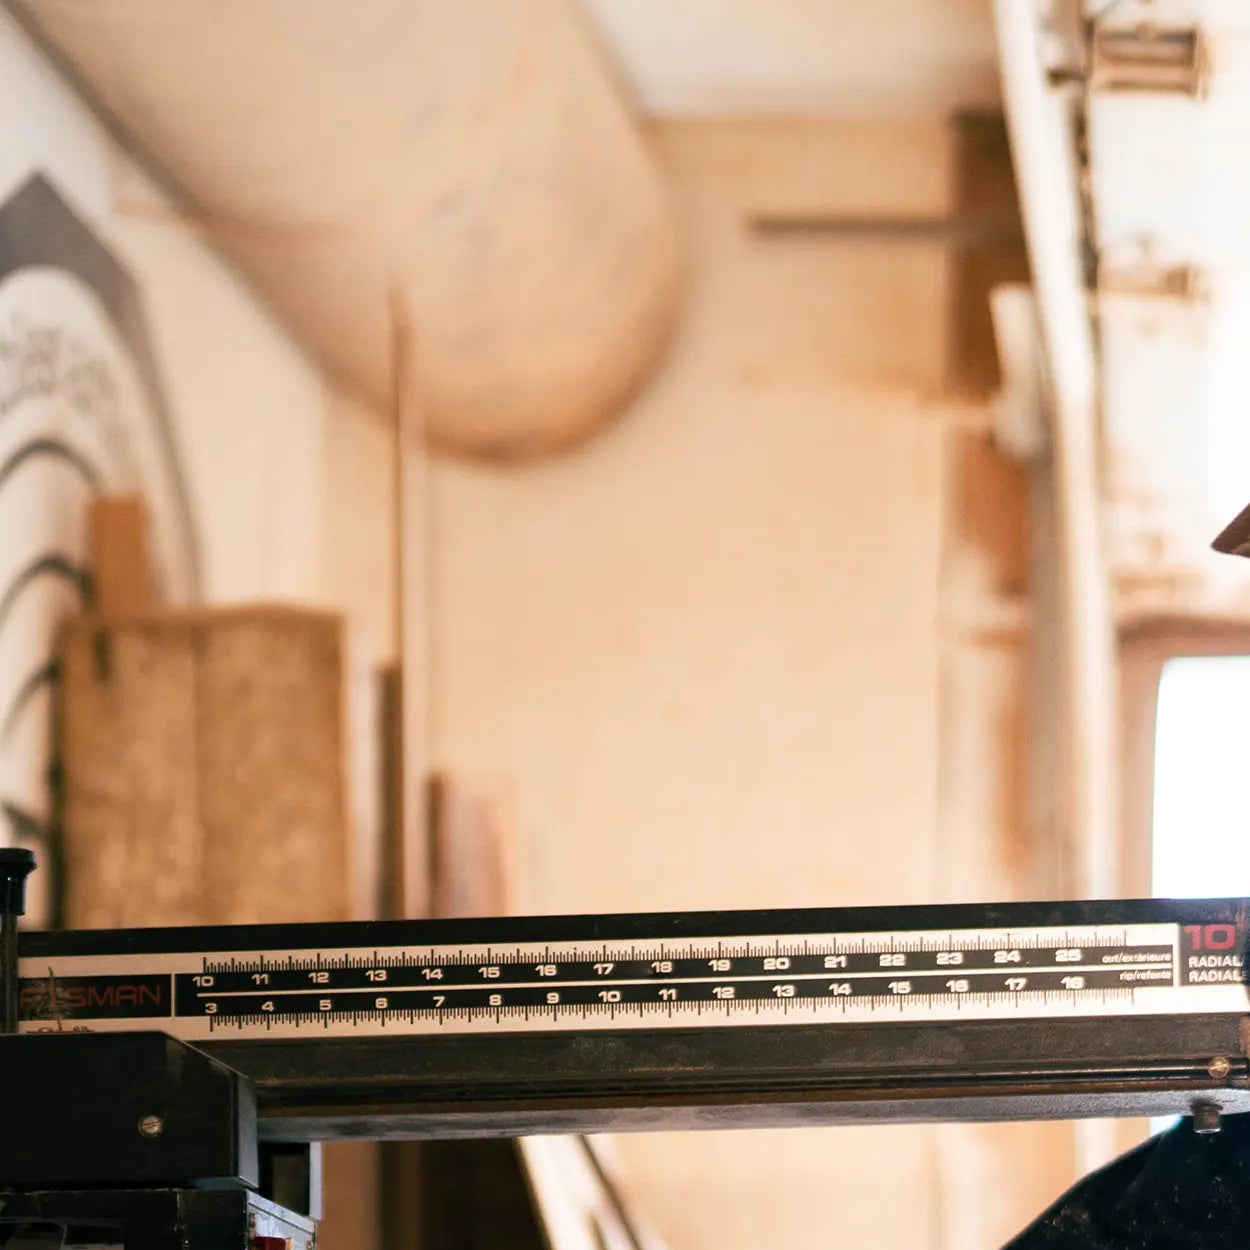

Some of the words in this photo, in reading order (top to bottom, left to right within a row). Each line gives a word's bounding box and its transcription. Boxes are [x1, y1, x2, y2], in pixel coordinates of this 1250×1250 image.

[1184, 924, 1235, 950] 10
[192, 975, 215, 987] 10
[251, 973, 269, 985] 11
[308, 971, 330, 984] 12
[365, 969, 387, 982] 13
[421, 968, 444, 980] 14
[478, 966, 501, 979] 15
[535, 964, 557, 977] 16
[593, 962, 615, 975] 17
[650, 960, 673, 973] 18
[708, 959, 731, 972] 19
[763, 957, 790, 971] 20
[824, 955, 847, 969] 21
[879, 953, 906, 967] 22
[936, 951, 964, 965] 23
[993, 949, 1021, 964] 24
[1055, 948, 1083, 962] 25
[204, 1002, 218, 1014] 3
[261, 1000, 275, 1012] 4
[319, 999, 332, 1011] 5
[375, 997, 388, 1009] 6
[432, 995, 446, 1008] 7
[489, 994, 502, 1006] 8
[546, 992, 560, 1005] 9
[598, 990, 621, 1003] 10
[658, 988, 677, 1001] 11
[712, 986, 735, 999] 12
[772, 984, 795, 998] 13
[828, 982, 852, 996] 14
[888, 981, 912, 994] 15
[945, 979, 970, 993] 16
[1004, 977, 1028, 991] 17
[1060, 976, 1085, 990] 18
